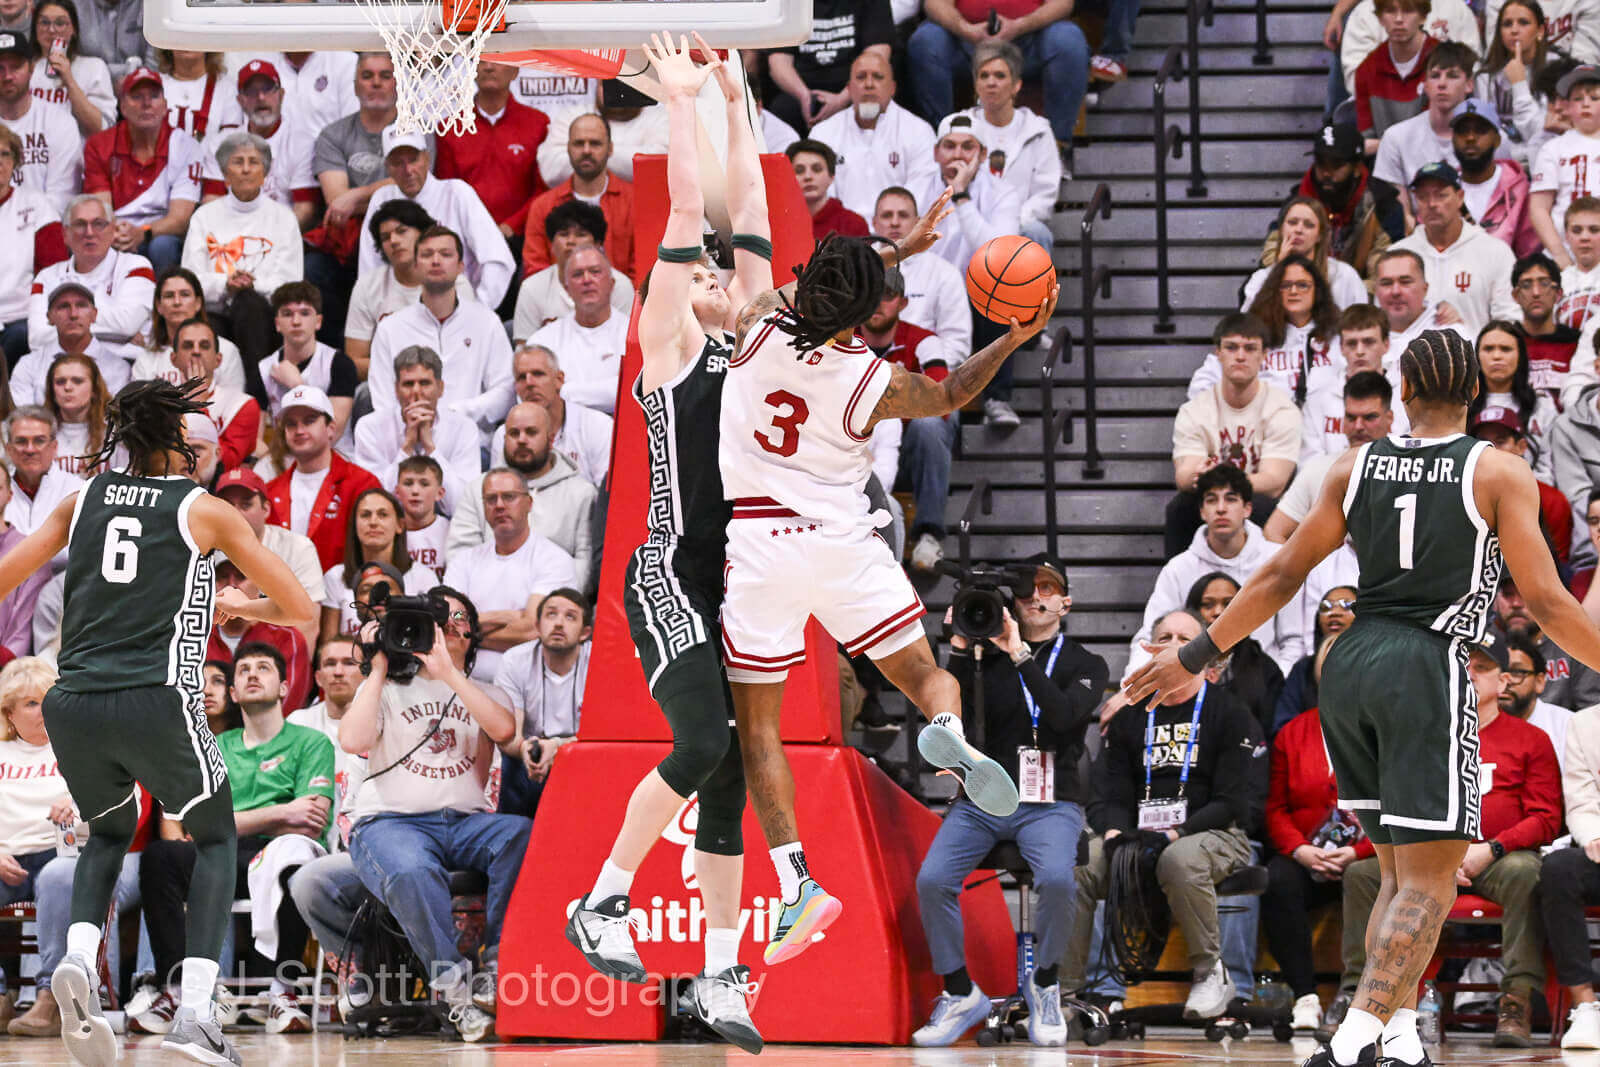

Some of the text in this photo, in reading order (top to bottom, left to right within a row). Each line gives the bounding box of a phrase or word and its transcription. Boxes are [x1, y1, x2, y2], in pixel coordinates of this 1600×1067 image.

[521, 77, 586, 96] INDIANA
[706, 355, 728, 373] SP
[754, 389, 809, 458] 3
[1364, 454, 1460, 483] FEARS JR.
[104, 484, 163, 508] SCOTT
[1394, 493, 1418, 570] 1
[101, 516, 143, 585] 6
[401, 701, 471, 726] INDIANA
[400, 754, 476, 780] BASKETBALL
